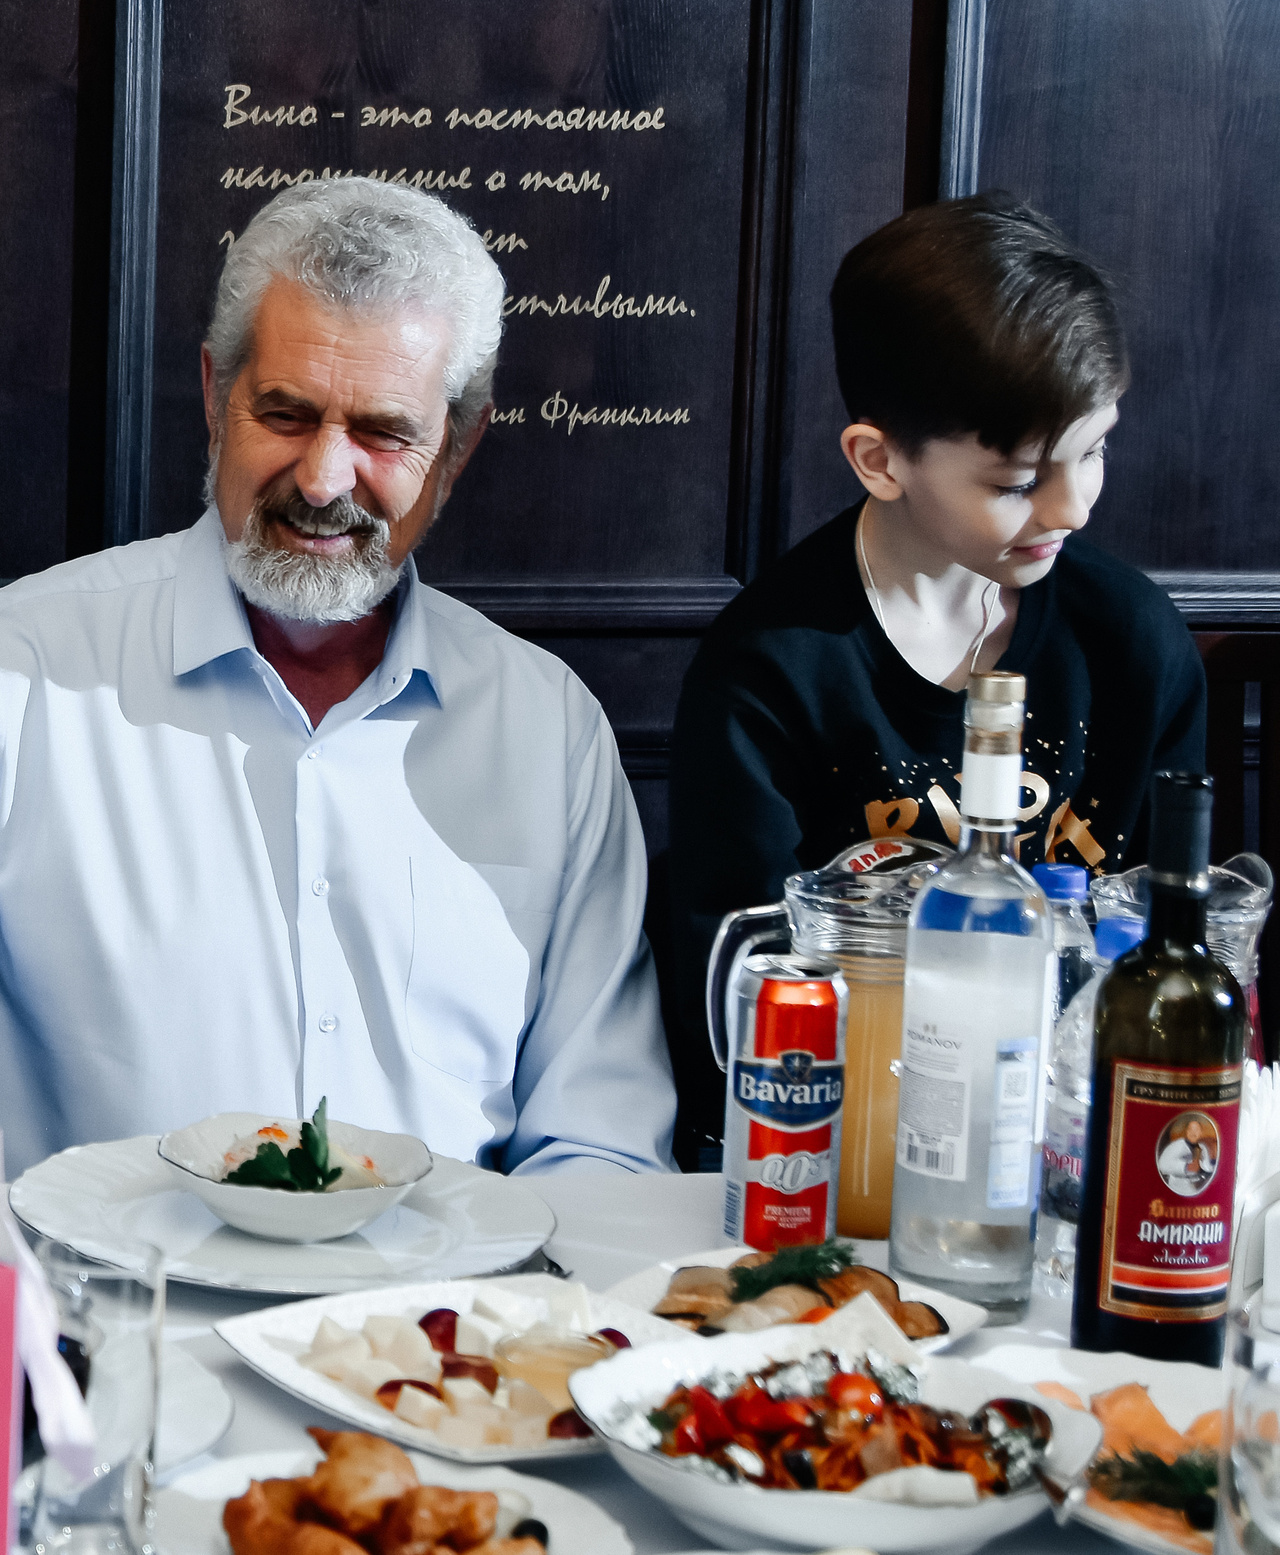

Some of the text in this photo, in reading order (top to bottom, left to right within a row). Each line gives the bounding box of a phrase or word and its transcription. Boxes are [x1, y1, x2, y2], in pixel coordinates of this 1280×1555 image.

[223, 84, 318, 129] Вино
[360, 105, 432, 128] это
[445, 106, 666, 131] постоянное
[485, 170, 506, 191] о
[519, 170, 610, 201] том,
[501, 274, 696, 319] стливыми.
[540, 391, 690, 436] Франклин
[739, 1071, 842, 1105] Bavaria
[764, 1204, 812, 1217] PREMIUM
[1137, 1221, 1225, 1246] АМИРАНИ
